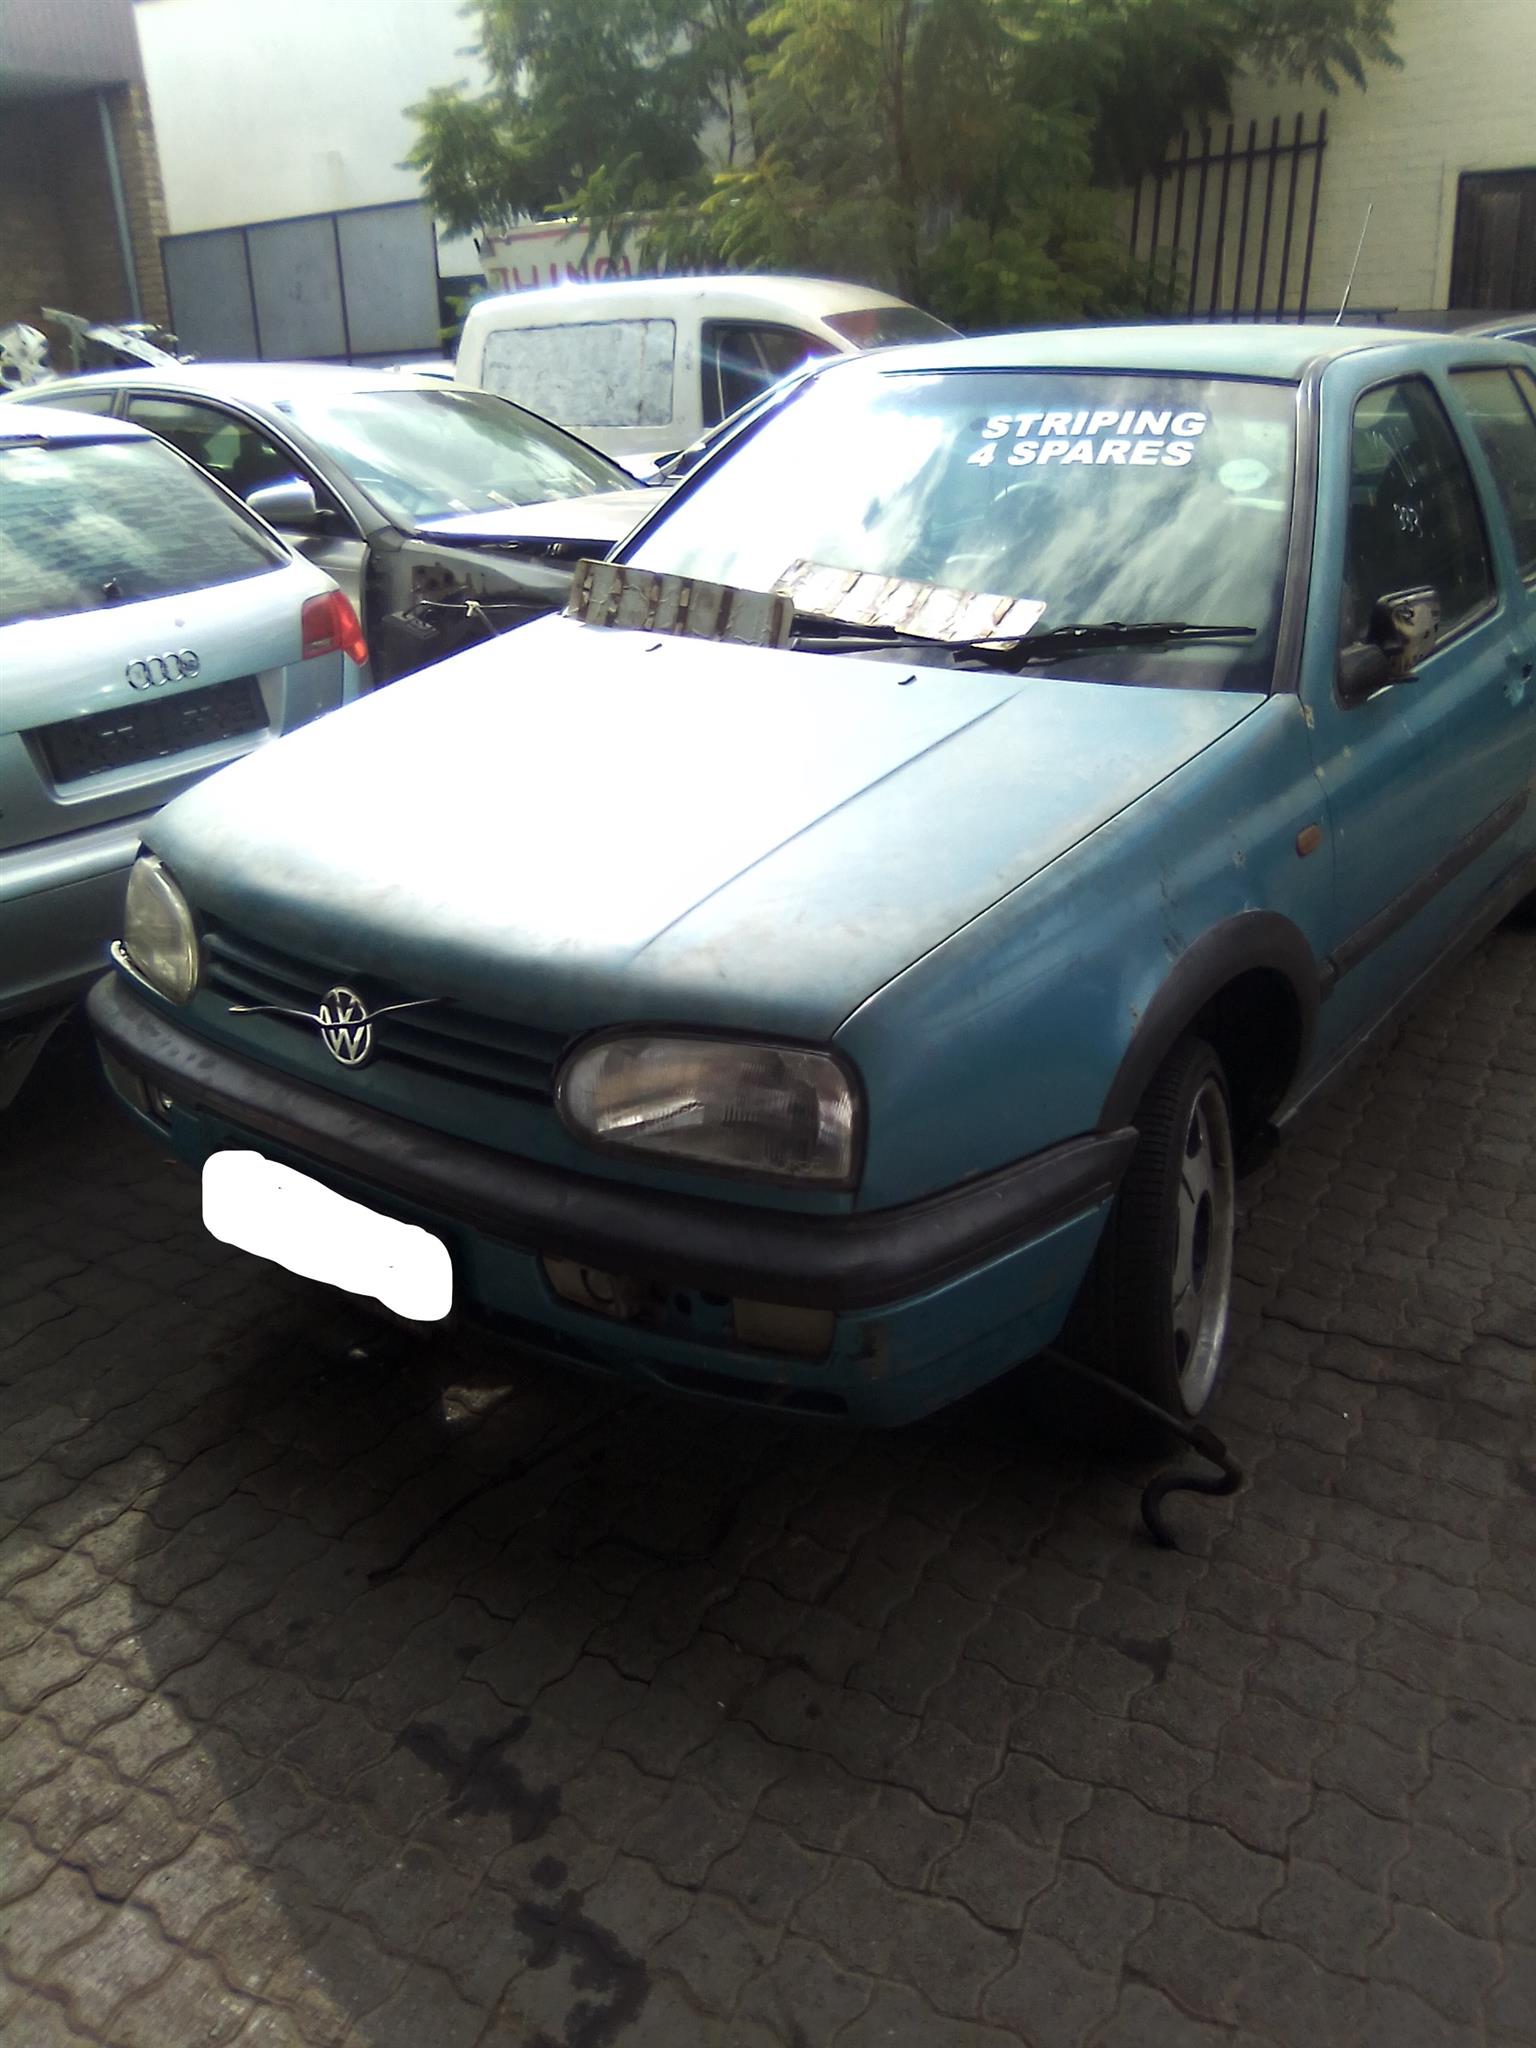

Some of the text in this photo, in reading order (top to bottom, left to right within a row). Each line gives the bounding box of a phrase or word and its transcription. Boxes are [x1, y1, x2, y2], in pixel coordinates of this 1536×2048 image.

[982, 411, 1207, 439] STRIPING
[967, 439, 1195, 467] 4 SPARES
